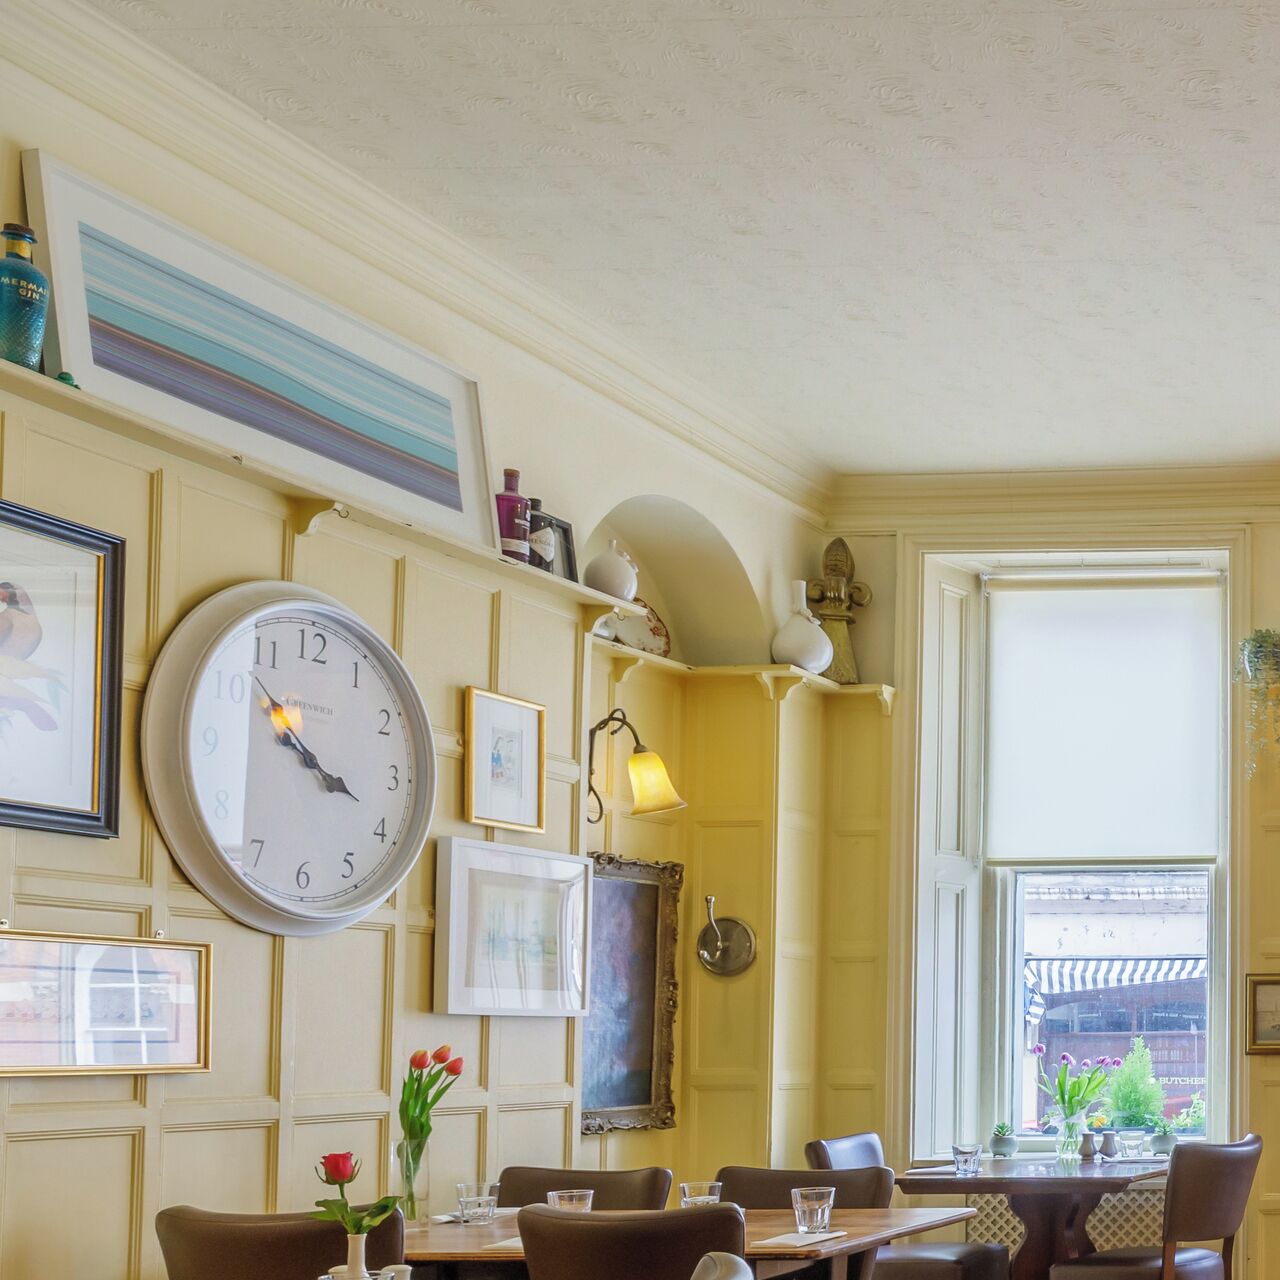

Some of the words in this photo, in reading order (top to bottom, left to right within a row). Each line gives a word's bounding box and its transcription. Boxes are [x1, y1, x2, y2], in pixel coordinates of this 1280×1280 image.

[0, 277, 48, 295] MERMAI
[19, 288, 40, 300] GIN
[255, 636, 279, 669] 11
[298, 628, 328, 666] 12
[215, 670, 246, 704] 10
[351, 661, 360, 689] 1
[286, 696, 334, 716] GREENWICH
[376, 708, 391, 737] 2
[202, 726, 219, 756] 9
[387, 764, 400, 792] 3
[214, 790, 230, 820] 8
[373, 817, 388, 844] 4
[250, 838, 265, 869] 7
[341, 851, 355, 879] 5
[295, 861, 311, 890] 6
